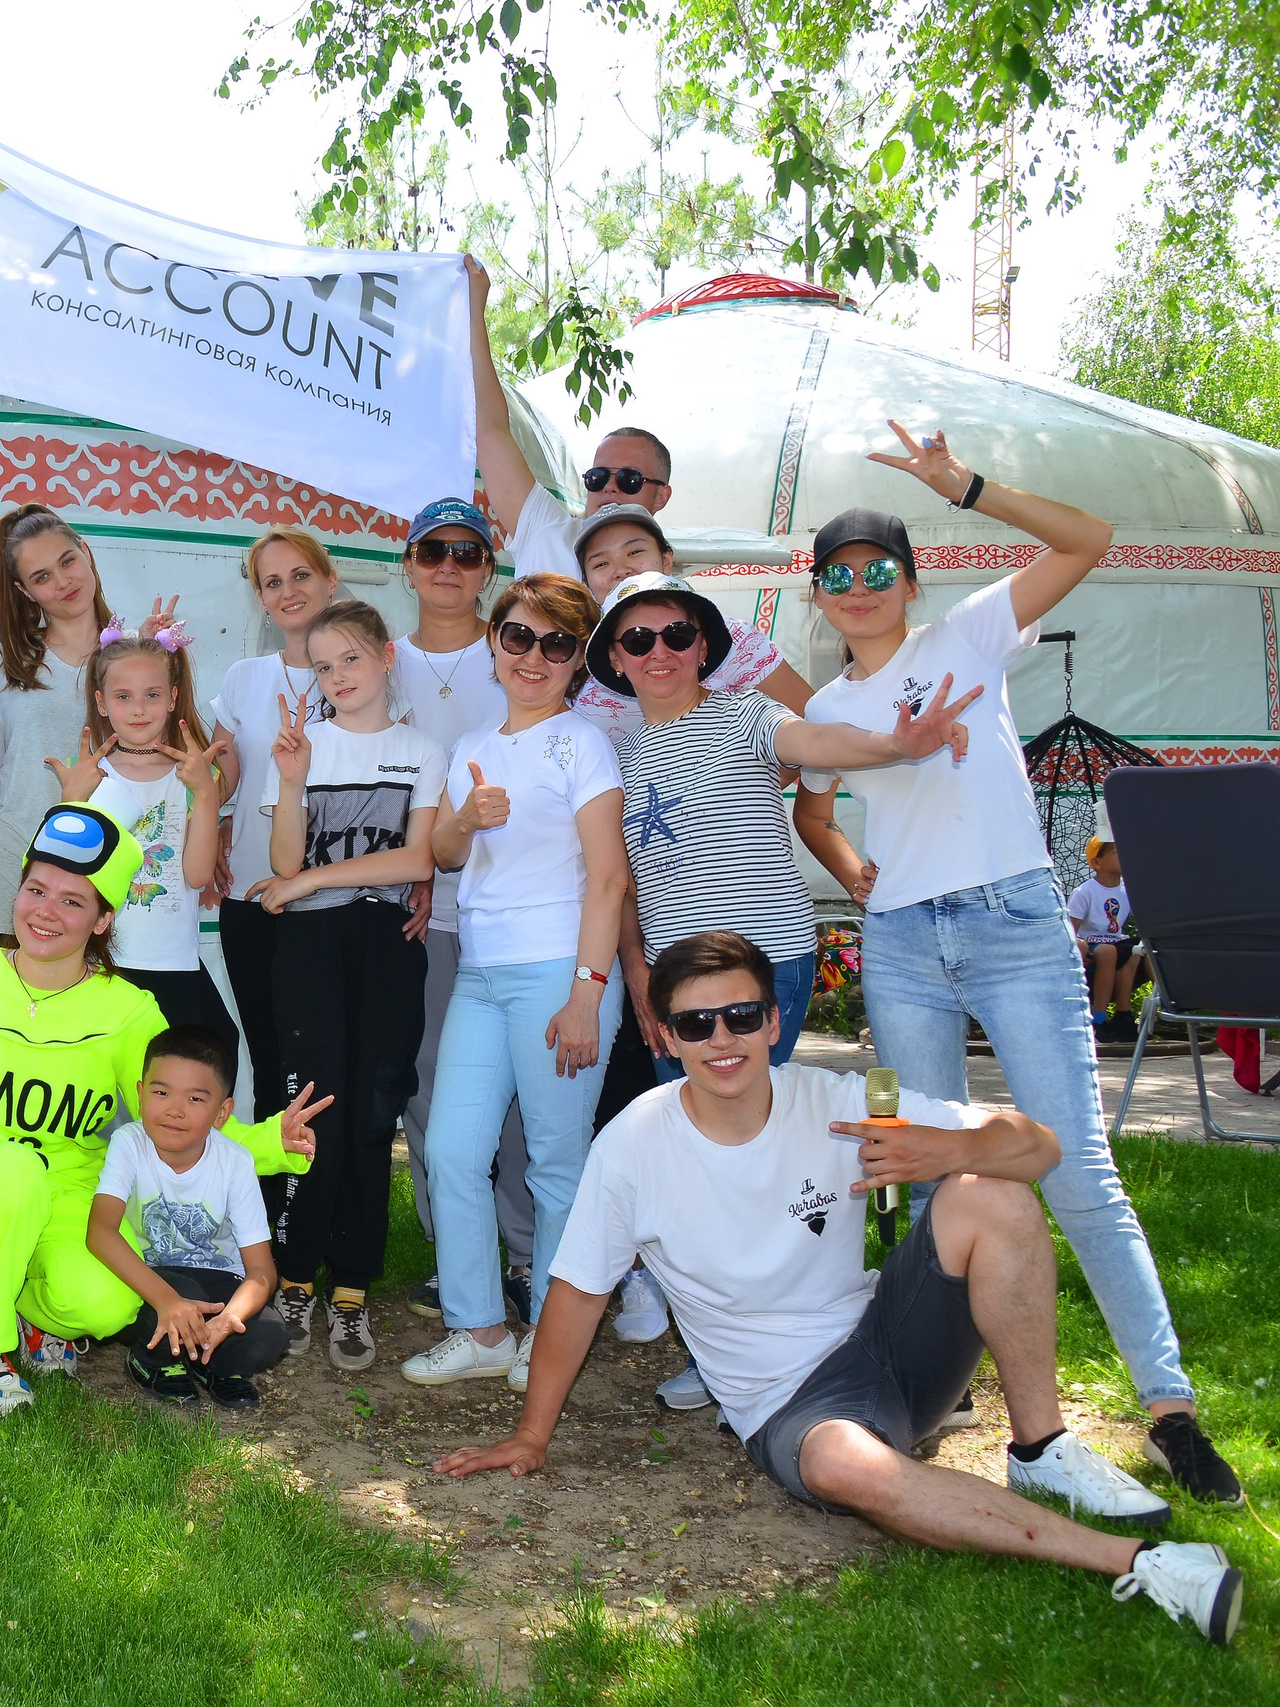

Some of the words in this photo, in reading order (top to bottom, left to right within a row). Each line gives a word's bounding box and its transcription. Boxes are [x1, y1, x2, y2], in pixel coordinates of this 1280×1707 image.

[41, 225, 392, 390] ACCOUNT
[287, 1073, 298, 1094] Life
[788, 1192, 837, 1218] Karabas
